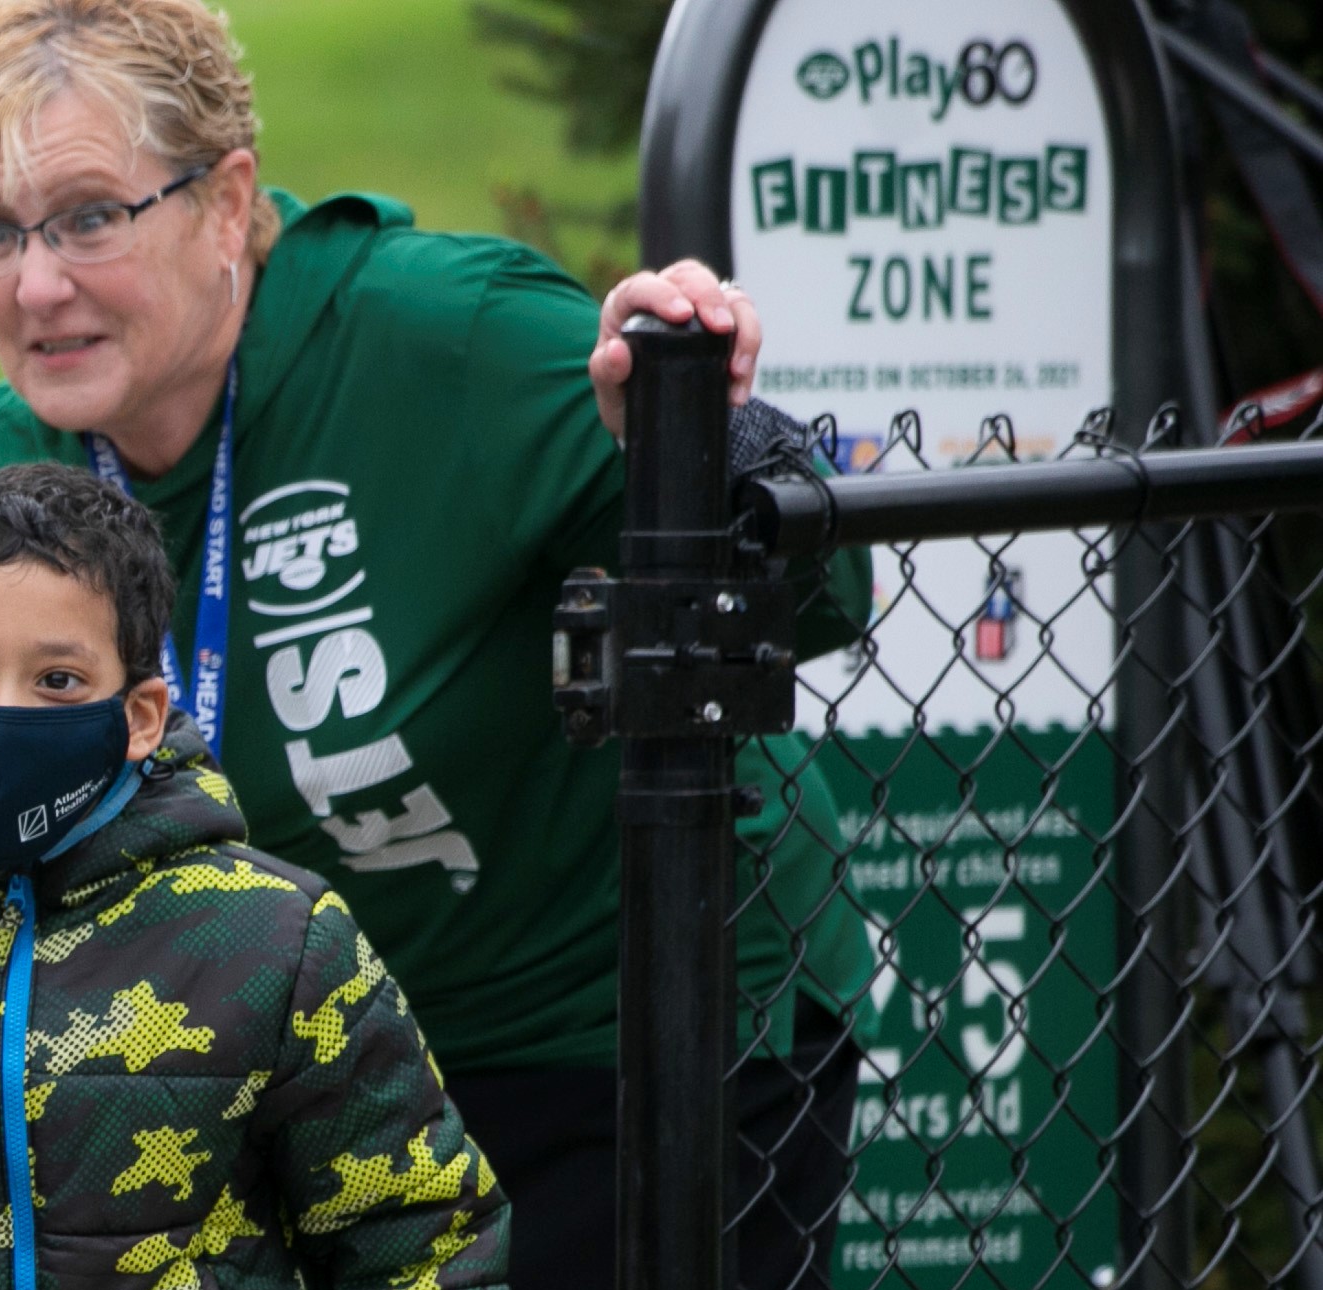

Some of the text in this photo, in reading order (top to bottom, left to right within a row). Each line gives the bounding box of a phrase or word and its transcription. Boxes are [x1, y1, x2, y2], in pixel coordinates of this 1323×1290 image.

[751, 145, 1088, 235] FITNESS
[848, 254, 993, 321] ZONE
[760, 365, 867, 392] DEDICATED
[876, 364, 902, 391] ON
[910, 363, 997, 391] OCTOBER
[241, 518, 359, 581] JETS
[244, 502, 345, 544] NEW YORK
[204, 517, 226, 600] START
[266, 627, 479, 872] JETS
[54, 780, 93, 808] Atlantic
[55, 793, 88, 817] Health
[955, 848, 1061, 887] children
[961, 905, 1027, 1079] 5
[960, 1079, 1019, 1137] old
[843, 1227, 1022, 1271] recommended
